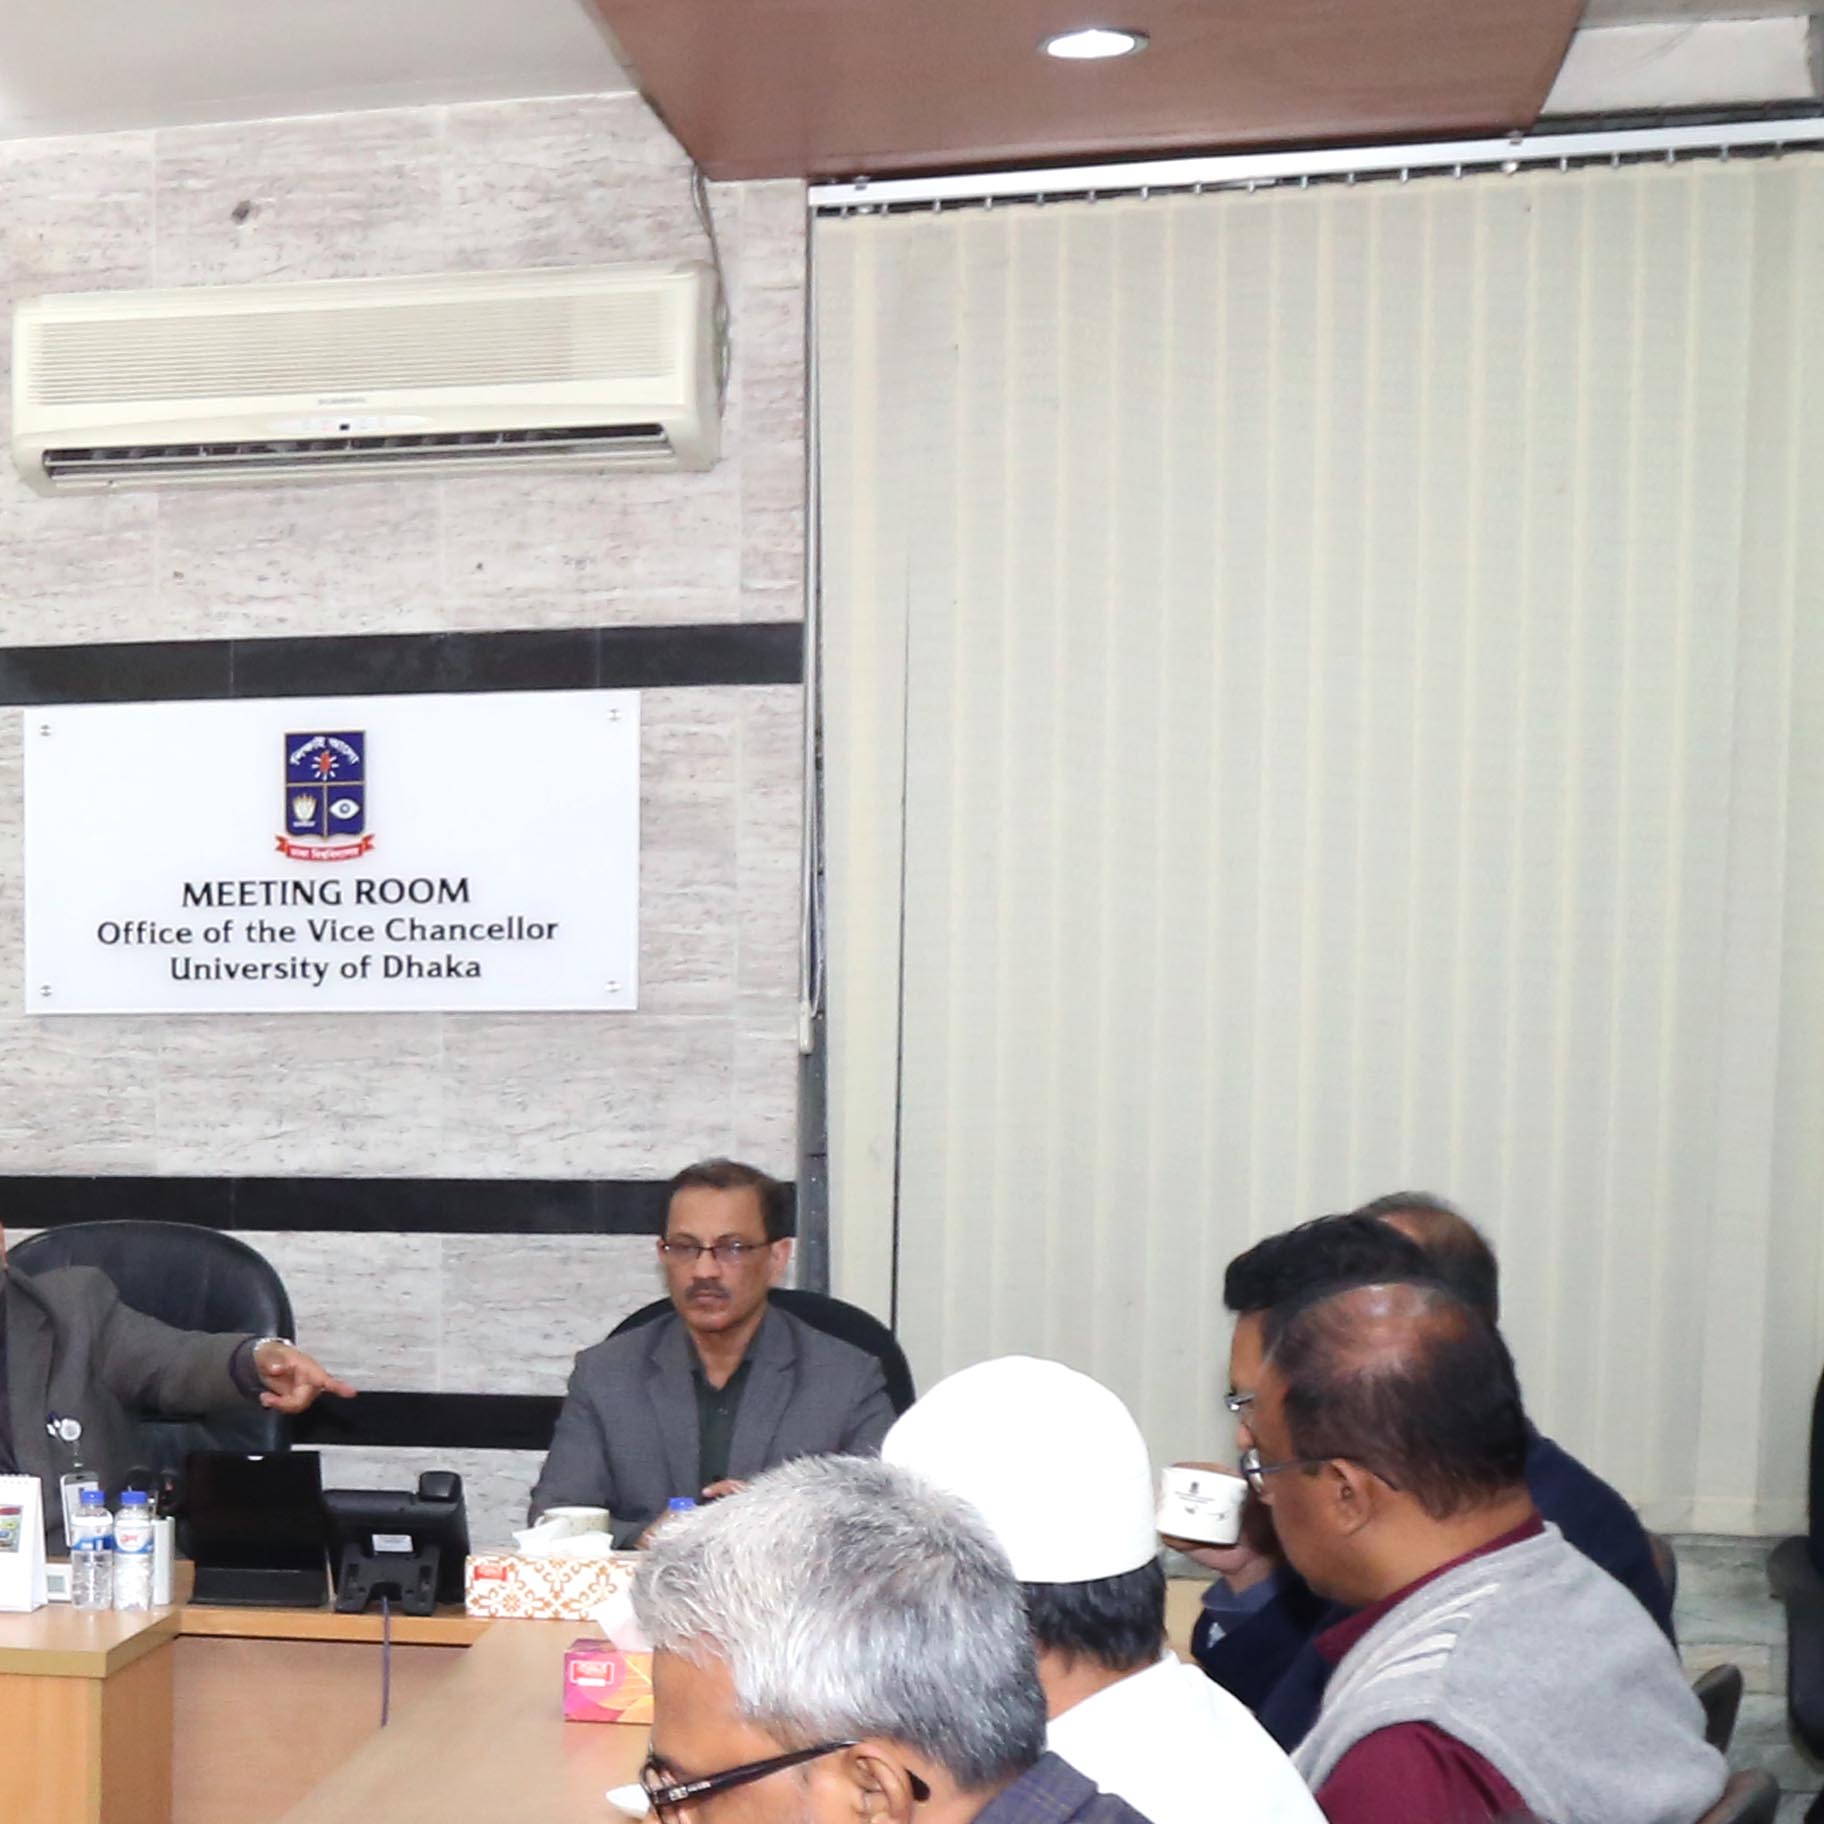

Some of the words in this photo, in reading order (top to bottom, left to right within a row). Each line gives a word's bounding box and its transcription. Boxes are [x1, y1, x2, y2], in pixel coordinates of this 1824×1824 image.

[182, 879, 342, 907] MEETING
[355, 877, 470, 905] ROOM
[97, 921, 192, 944] Office
[203, 919, 234, 943] of
[246, 919, 296, 943] the
[307, 919, 375, 942] Vice
[385, 915, 558, 942] Chancellor
[171, 956, 329, 987] University
[340, 955, 371, 979] of
[383, 954, 481, 978] Dhaka
